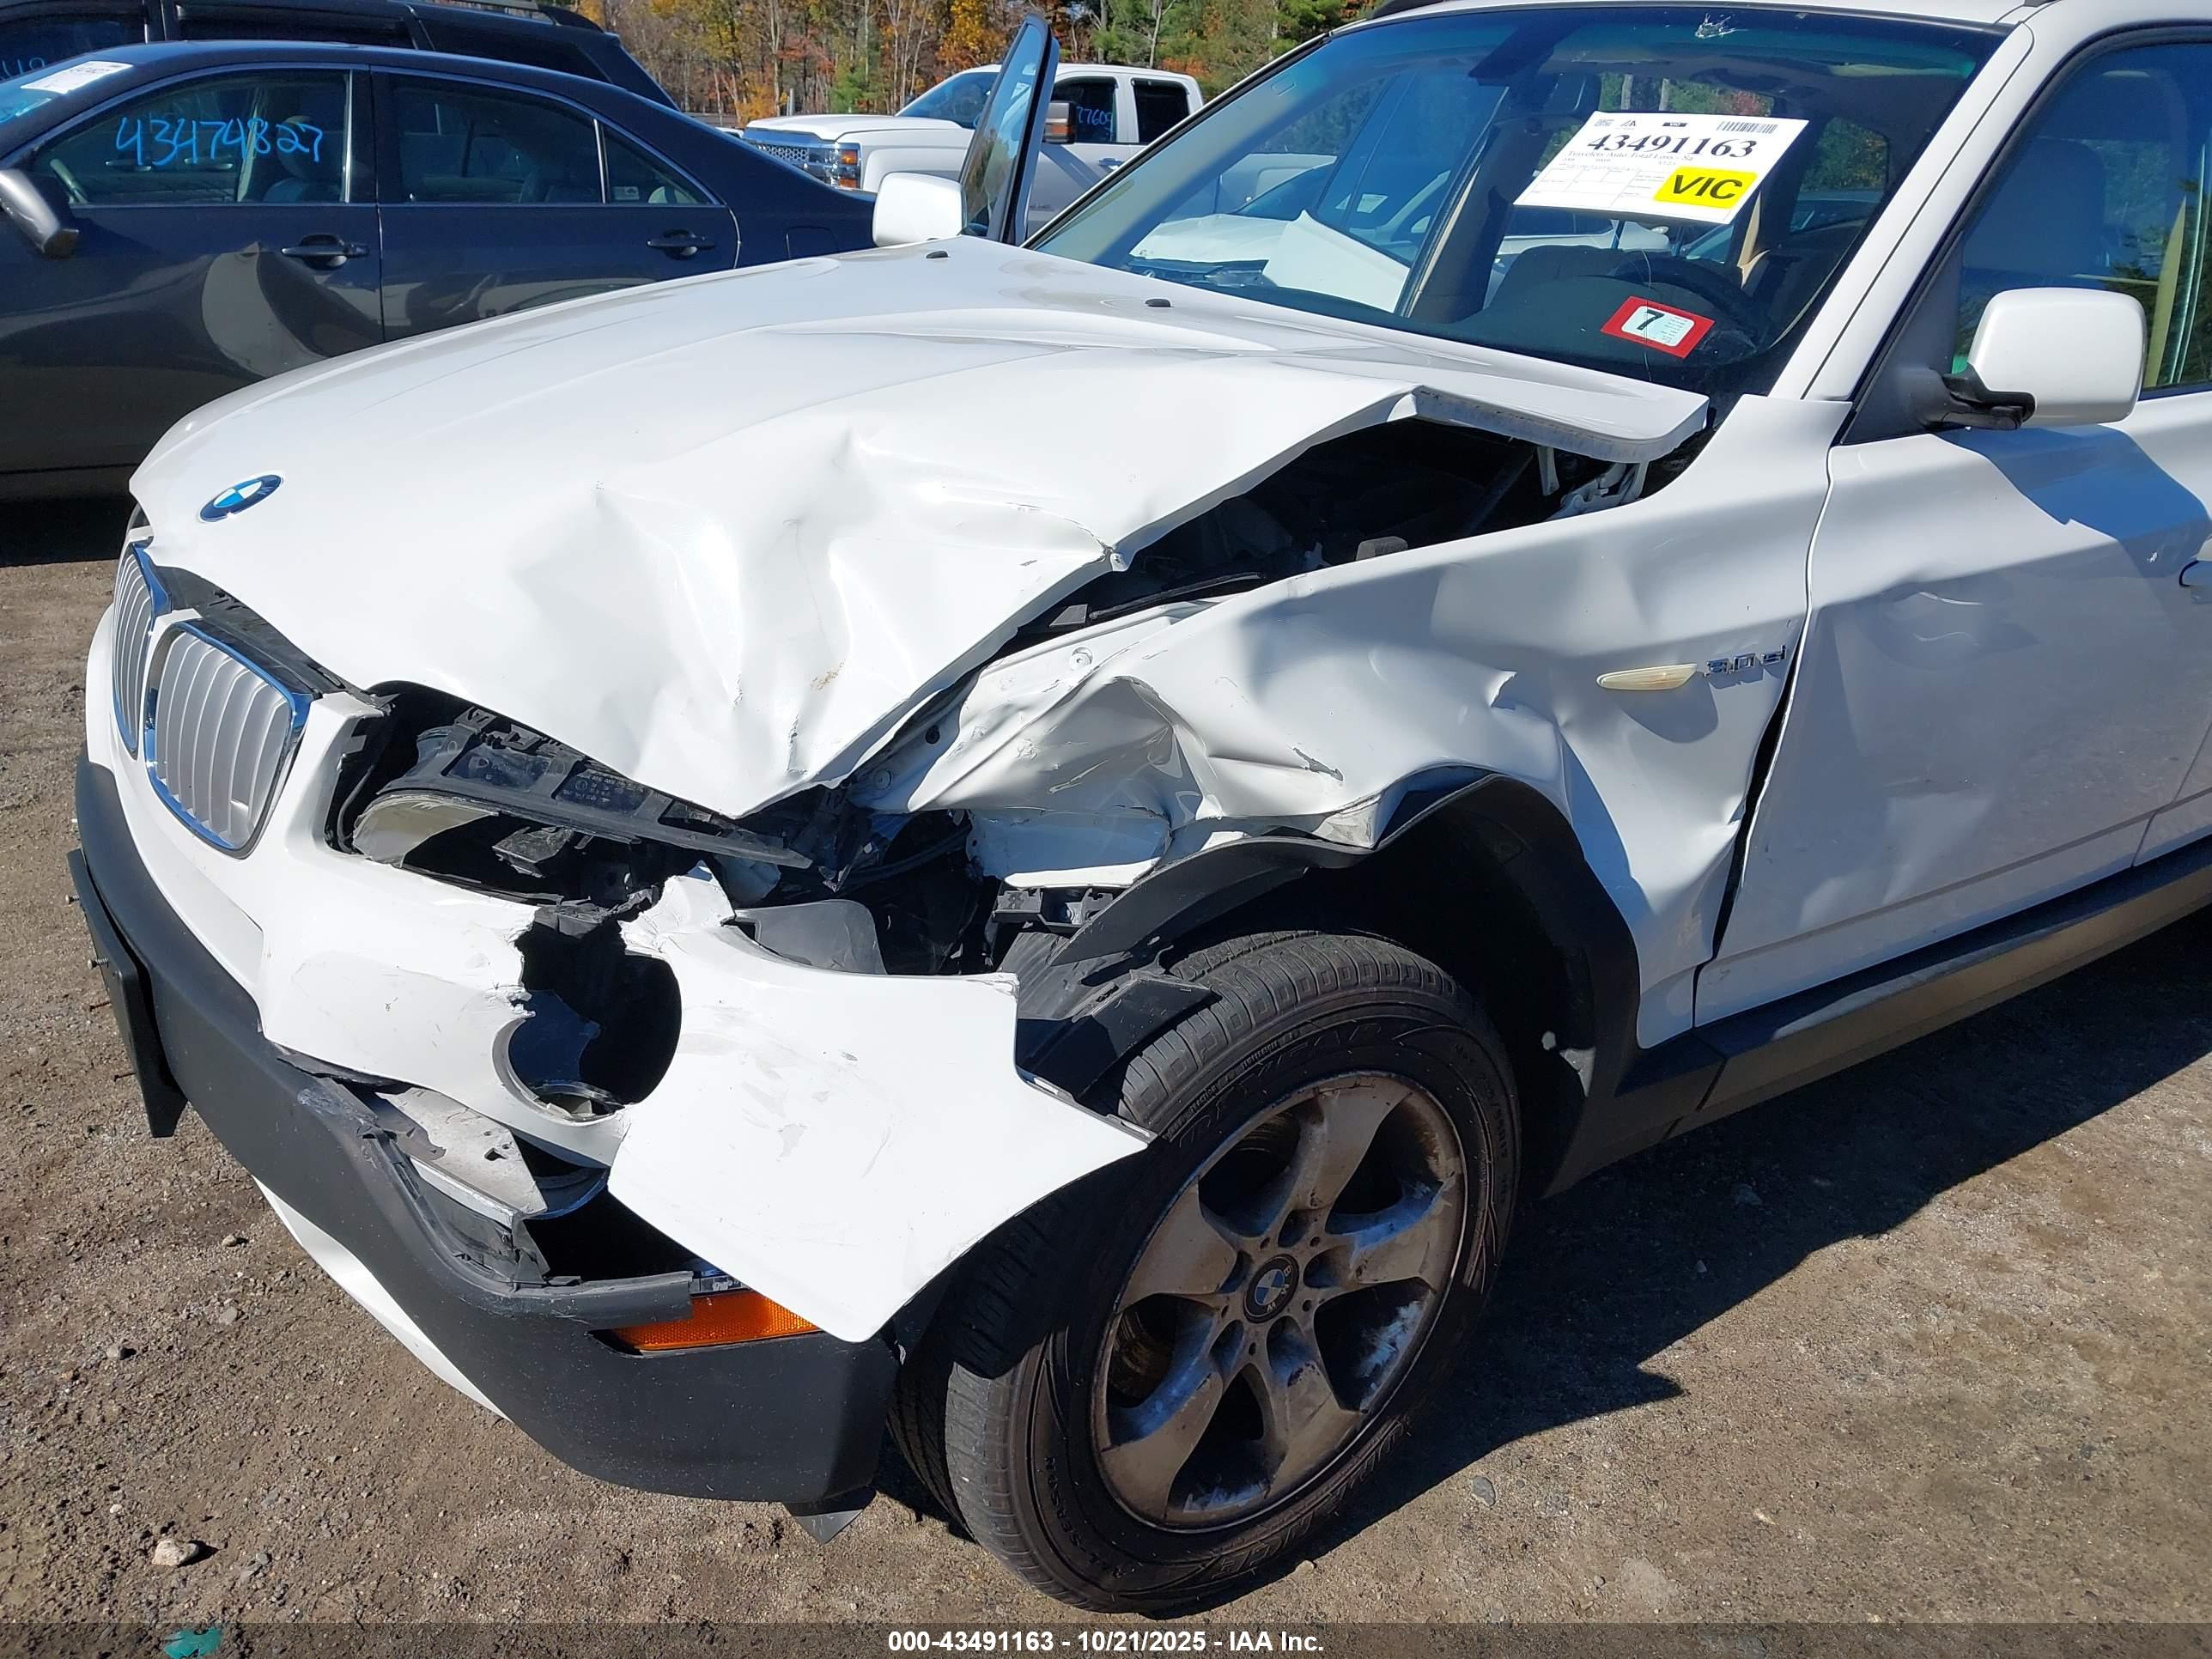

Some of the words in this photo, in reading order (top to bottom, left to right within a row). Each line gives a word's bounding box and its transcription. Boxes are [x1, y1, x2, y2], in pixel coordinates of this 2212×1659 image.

[116, 118, 323, 166] 43474827
[1587, 134, 1757, 158] 43491163
[1673, 174, 1743, 200] VIC
[1637, 308, 1665, 331] 7
